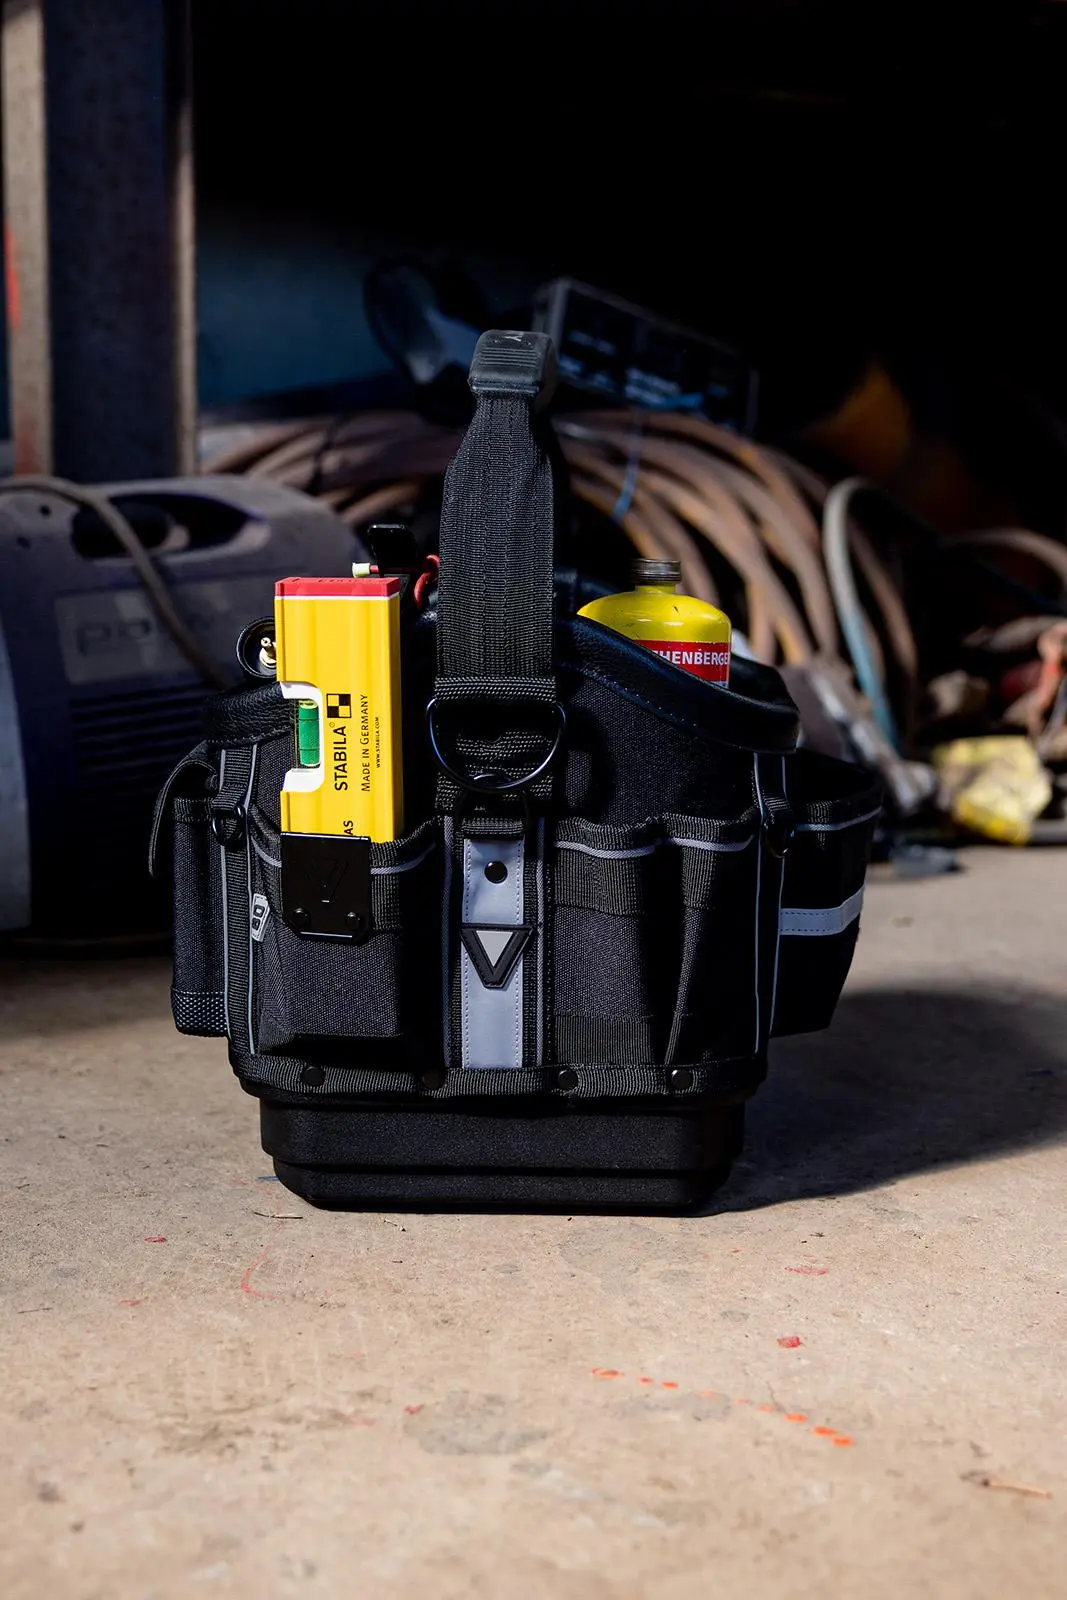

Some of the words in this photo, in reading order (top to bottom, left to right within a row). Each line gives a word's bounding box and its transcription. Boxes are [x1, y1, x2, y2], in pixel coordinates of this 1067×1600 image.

[652, 650, 730, 665] HENBERGE
[360, 694, 370, 745] GERMANY
[332, 725, 348, 791] STABILA
[362, 748, 370, 759] IN
[361, 762, 371, 792] MADE
